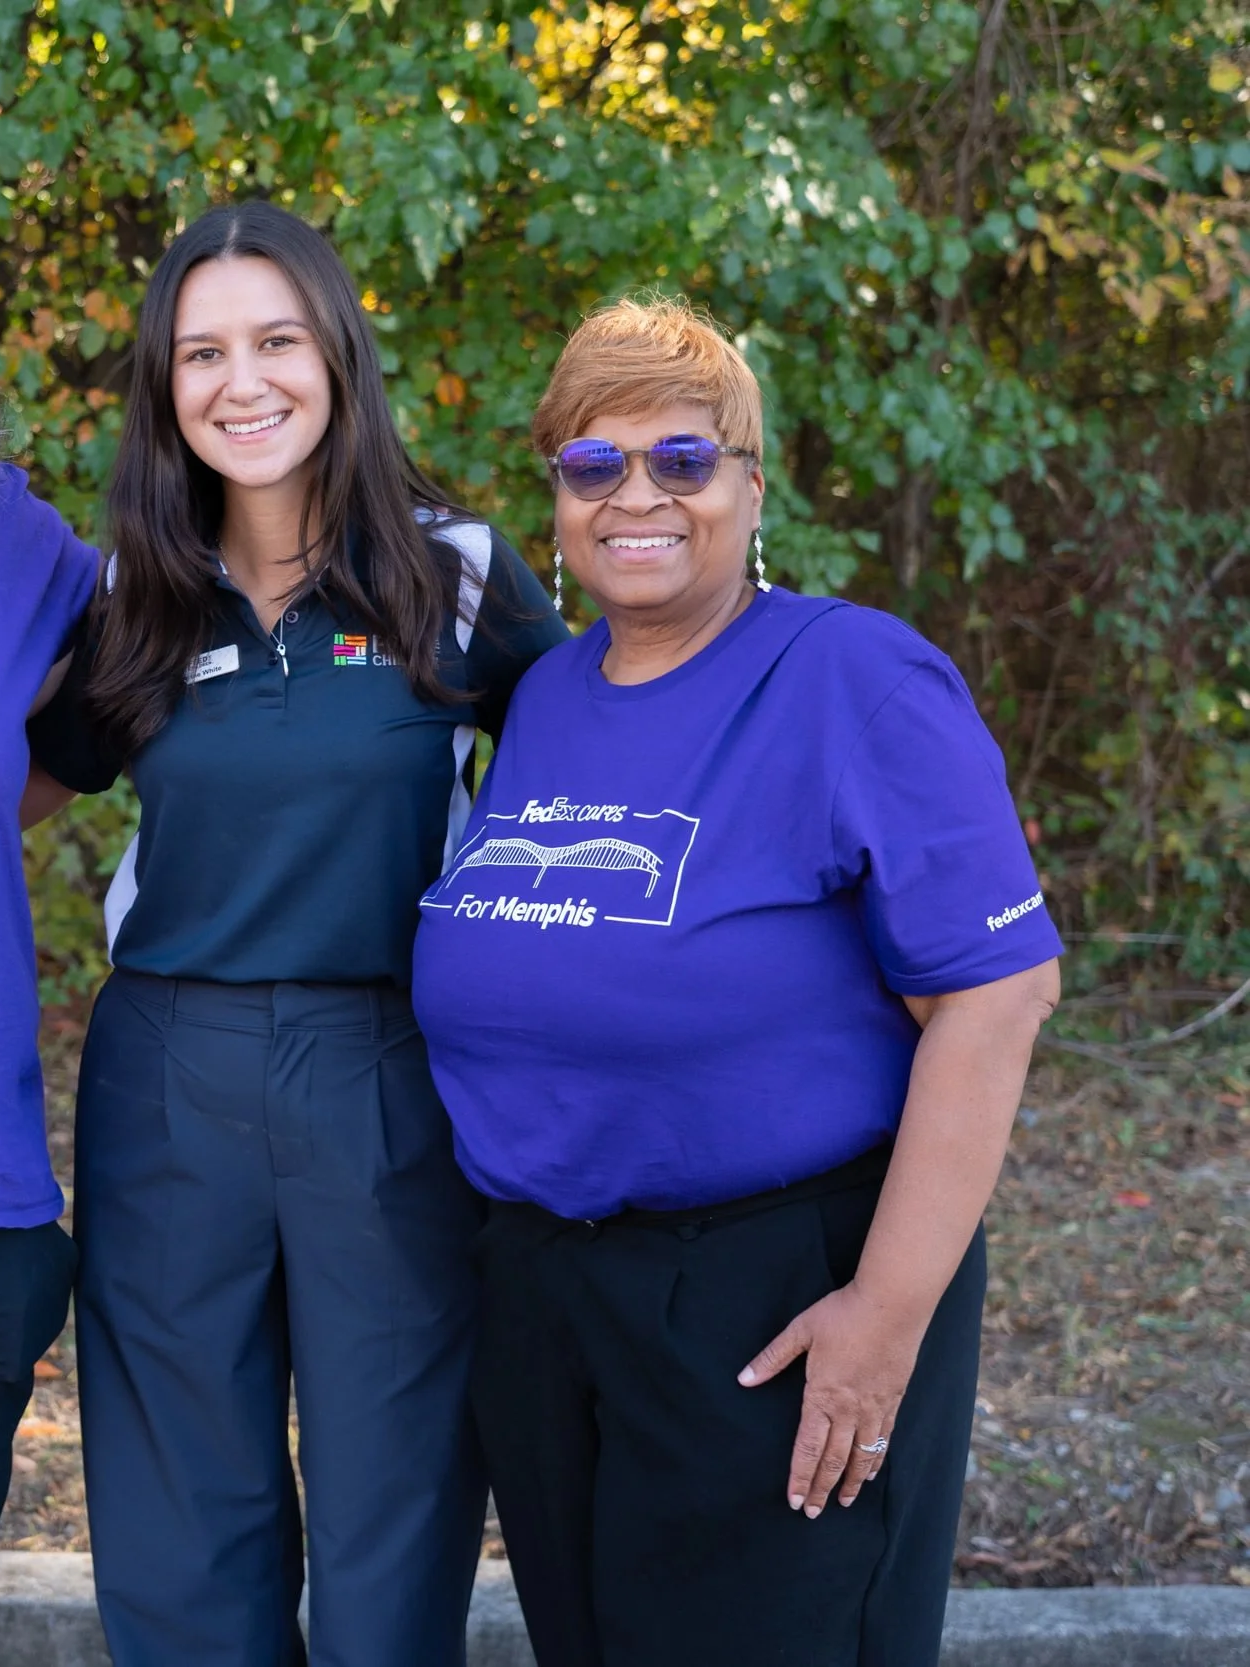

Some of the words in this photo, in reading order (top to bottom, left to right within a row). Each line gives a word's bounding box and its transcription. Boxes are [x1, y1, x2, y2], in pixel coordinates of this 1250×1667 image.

[202, 666, 222, 676] White
[518, 797, 580, 823] FedEx
[577, 804, 628, 822] cares
[454, 894, 493, 917] For
[490, 896, 597, 929] Memphis
